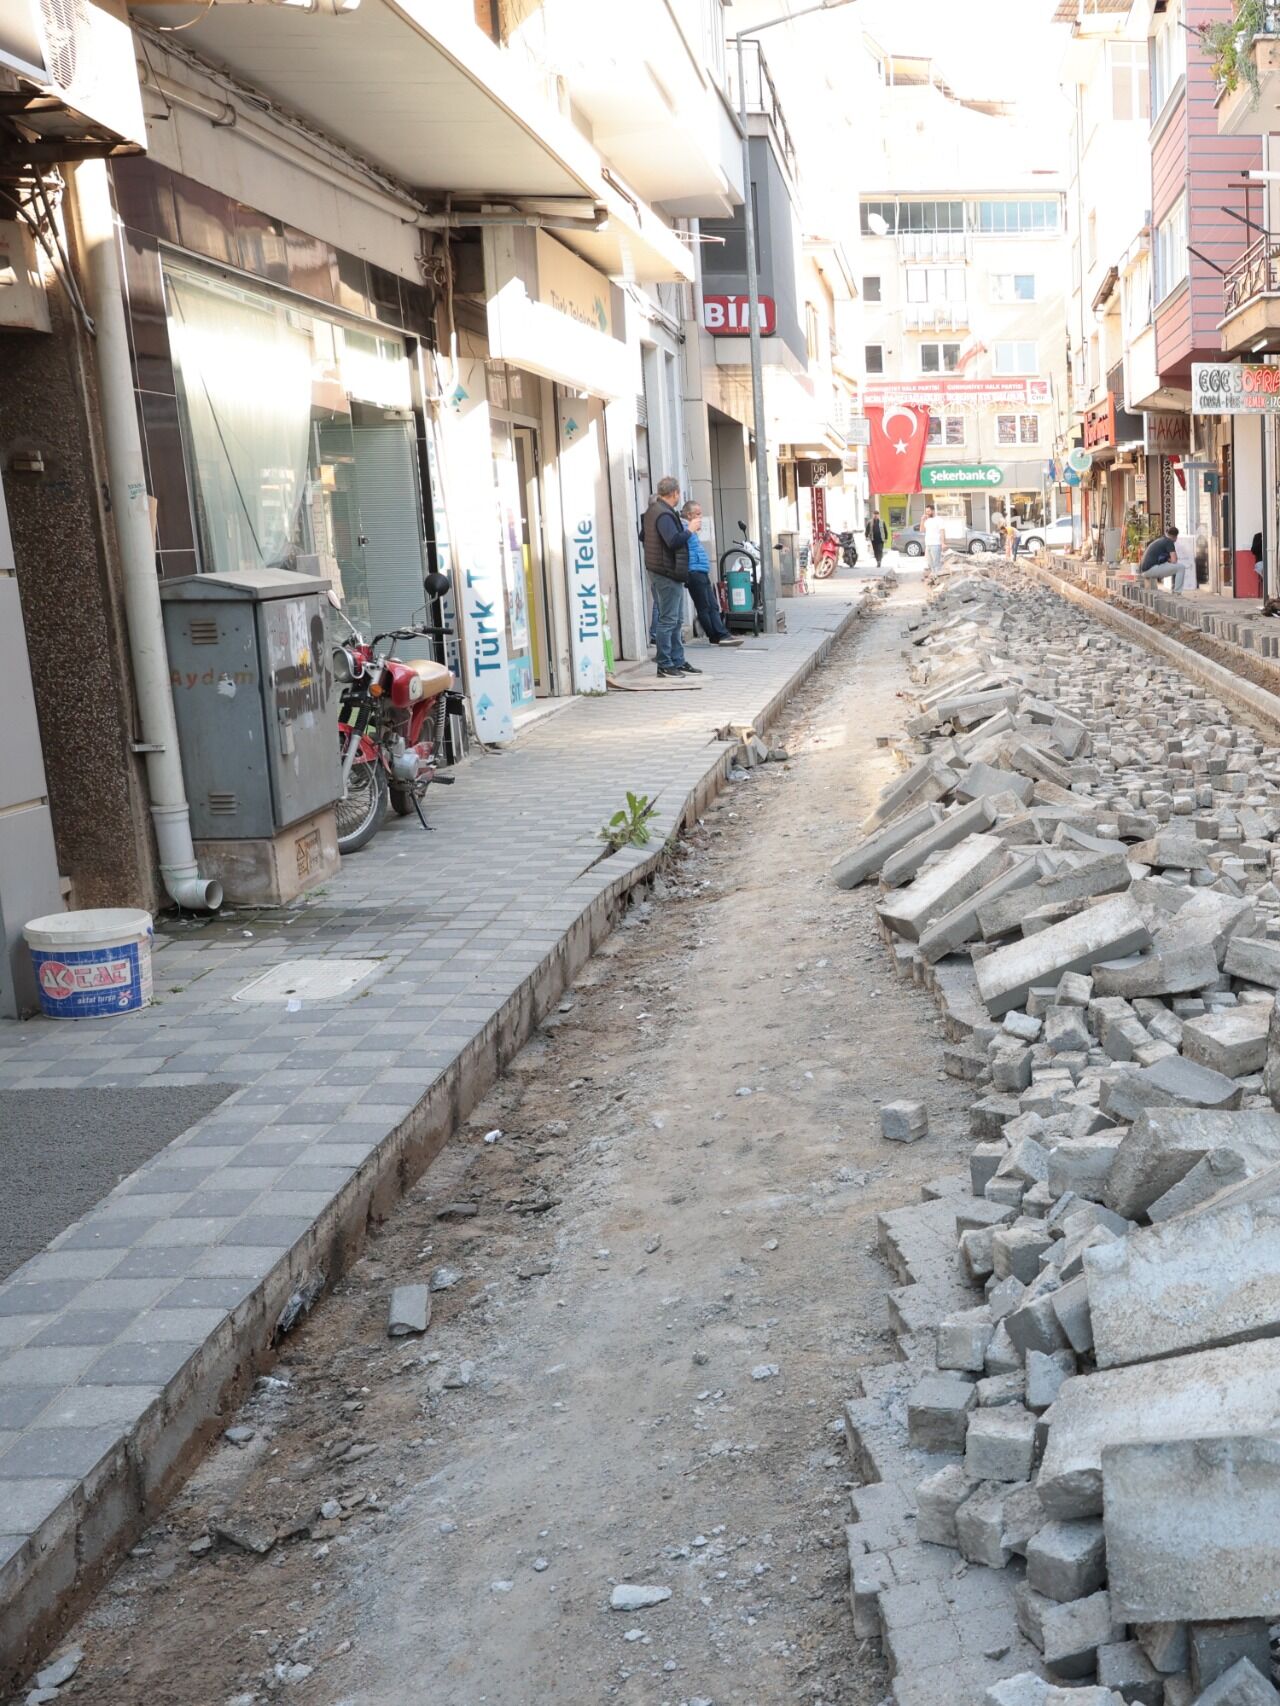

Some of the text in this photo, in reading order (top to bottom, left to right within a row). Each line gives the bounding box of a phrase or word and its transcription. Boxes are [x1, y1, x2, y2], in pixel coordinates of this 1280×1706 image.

[704, 295, 768, 328] BİM
[1199, 369, 1280, 393] EGE SOFRA
[1148, 416, 1190, 441] HAKAN
[930, 469, 986, 485] Şekerbank
[577, 583, 599, 643] Türk
[469, 599, 502, 678] Türk
